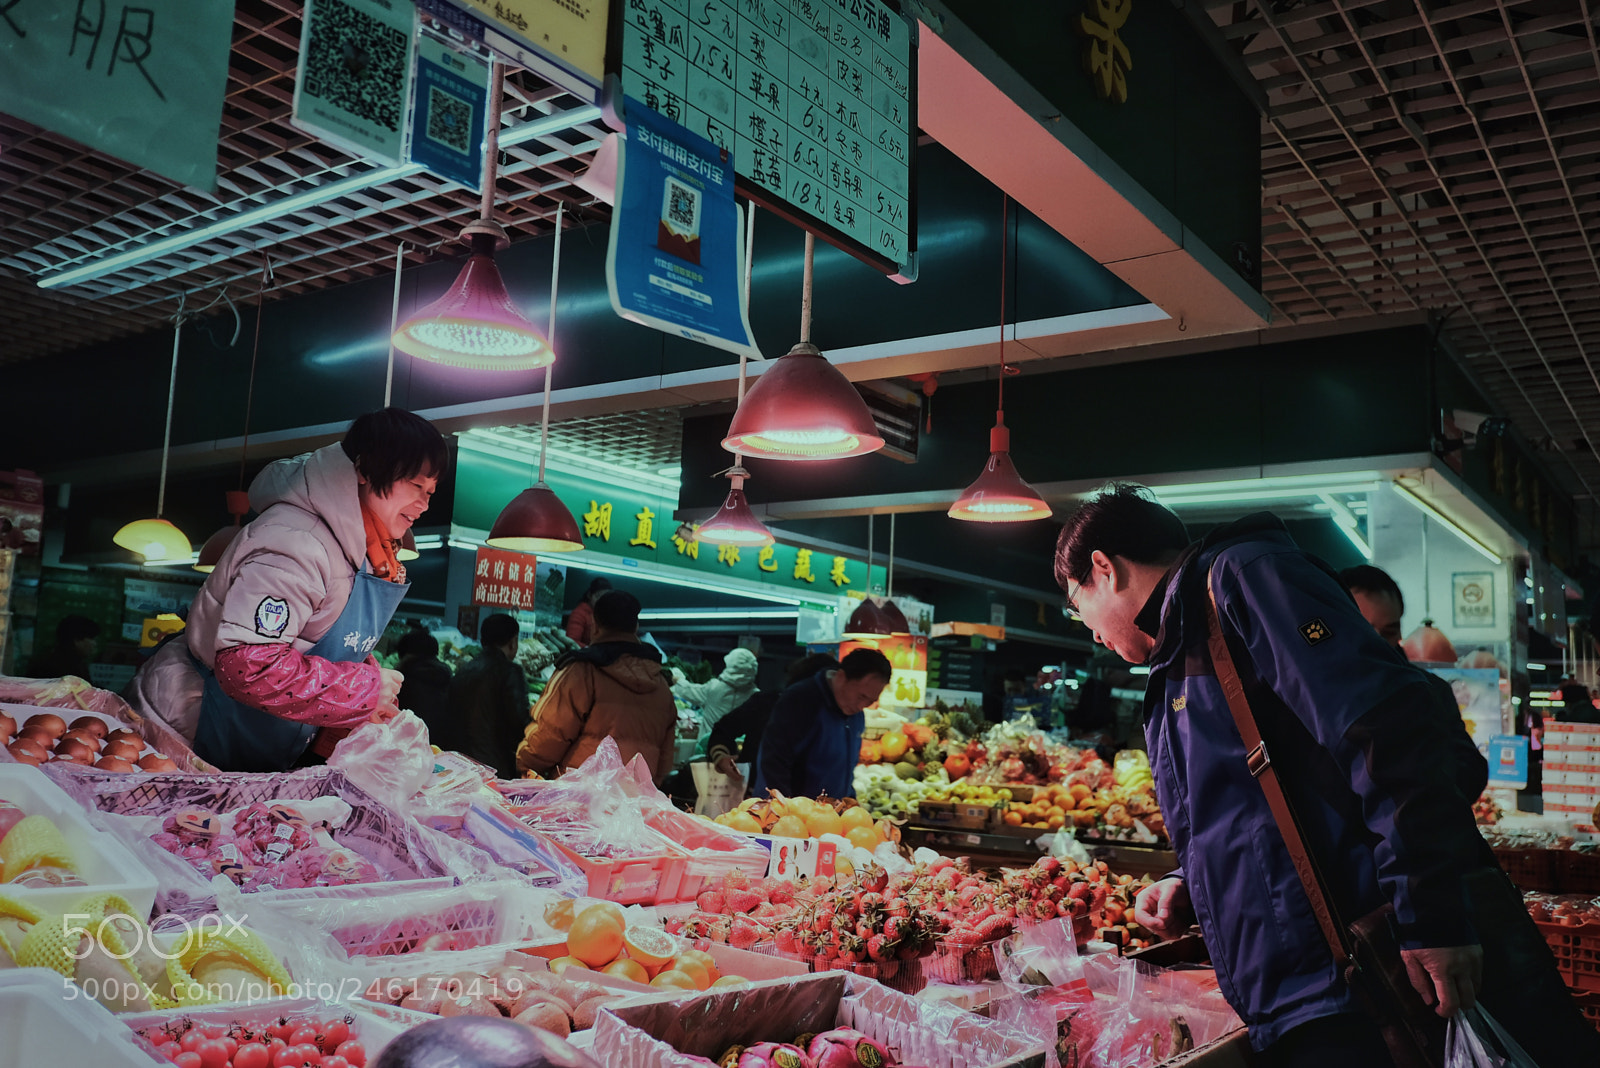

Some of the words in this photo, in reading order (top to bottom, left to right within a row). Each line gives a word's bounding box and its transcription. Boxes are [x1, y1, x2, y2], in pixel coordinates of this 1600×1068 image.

[832, 0, 891, 42] 公示牌
[834, 24, 862, 57] 品名
[749, 71, 780, 112] 苹果
[748, 111, 784, 153] 橙子
[835, 129, 863, 167] 冬枣
[636, 124, 724, 186] 支付就用支付宝
[749, 148, 782, 189] 蓝莓
[792, 181, 825, 214] 18元
[830, 160, 864, 199] 奇异果
[476, 558, 535, 584] 政府储备
[475, 582, 533, 608] 商品投放点
